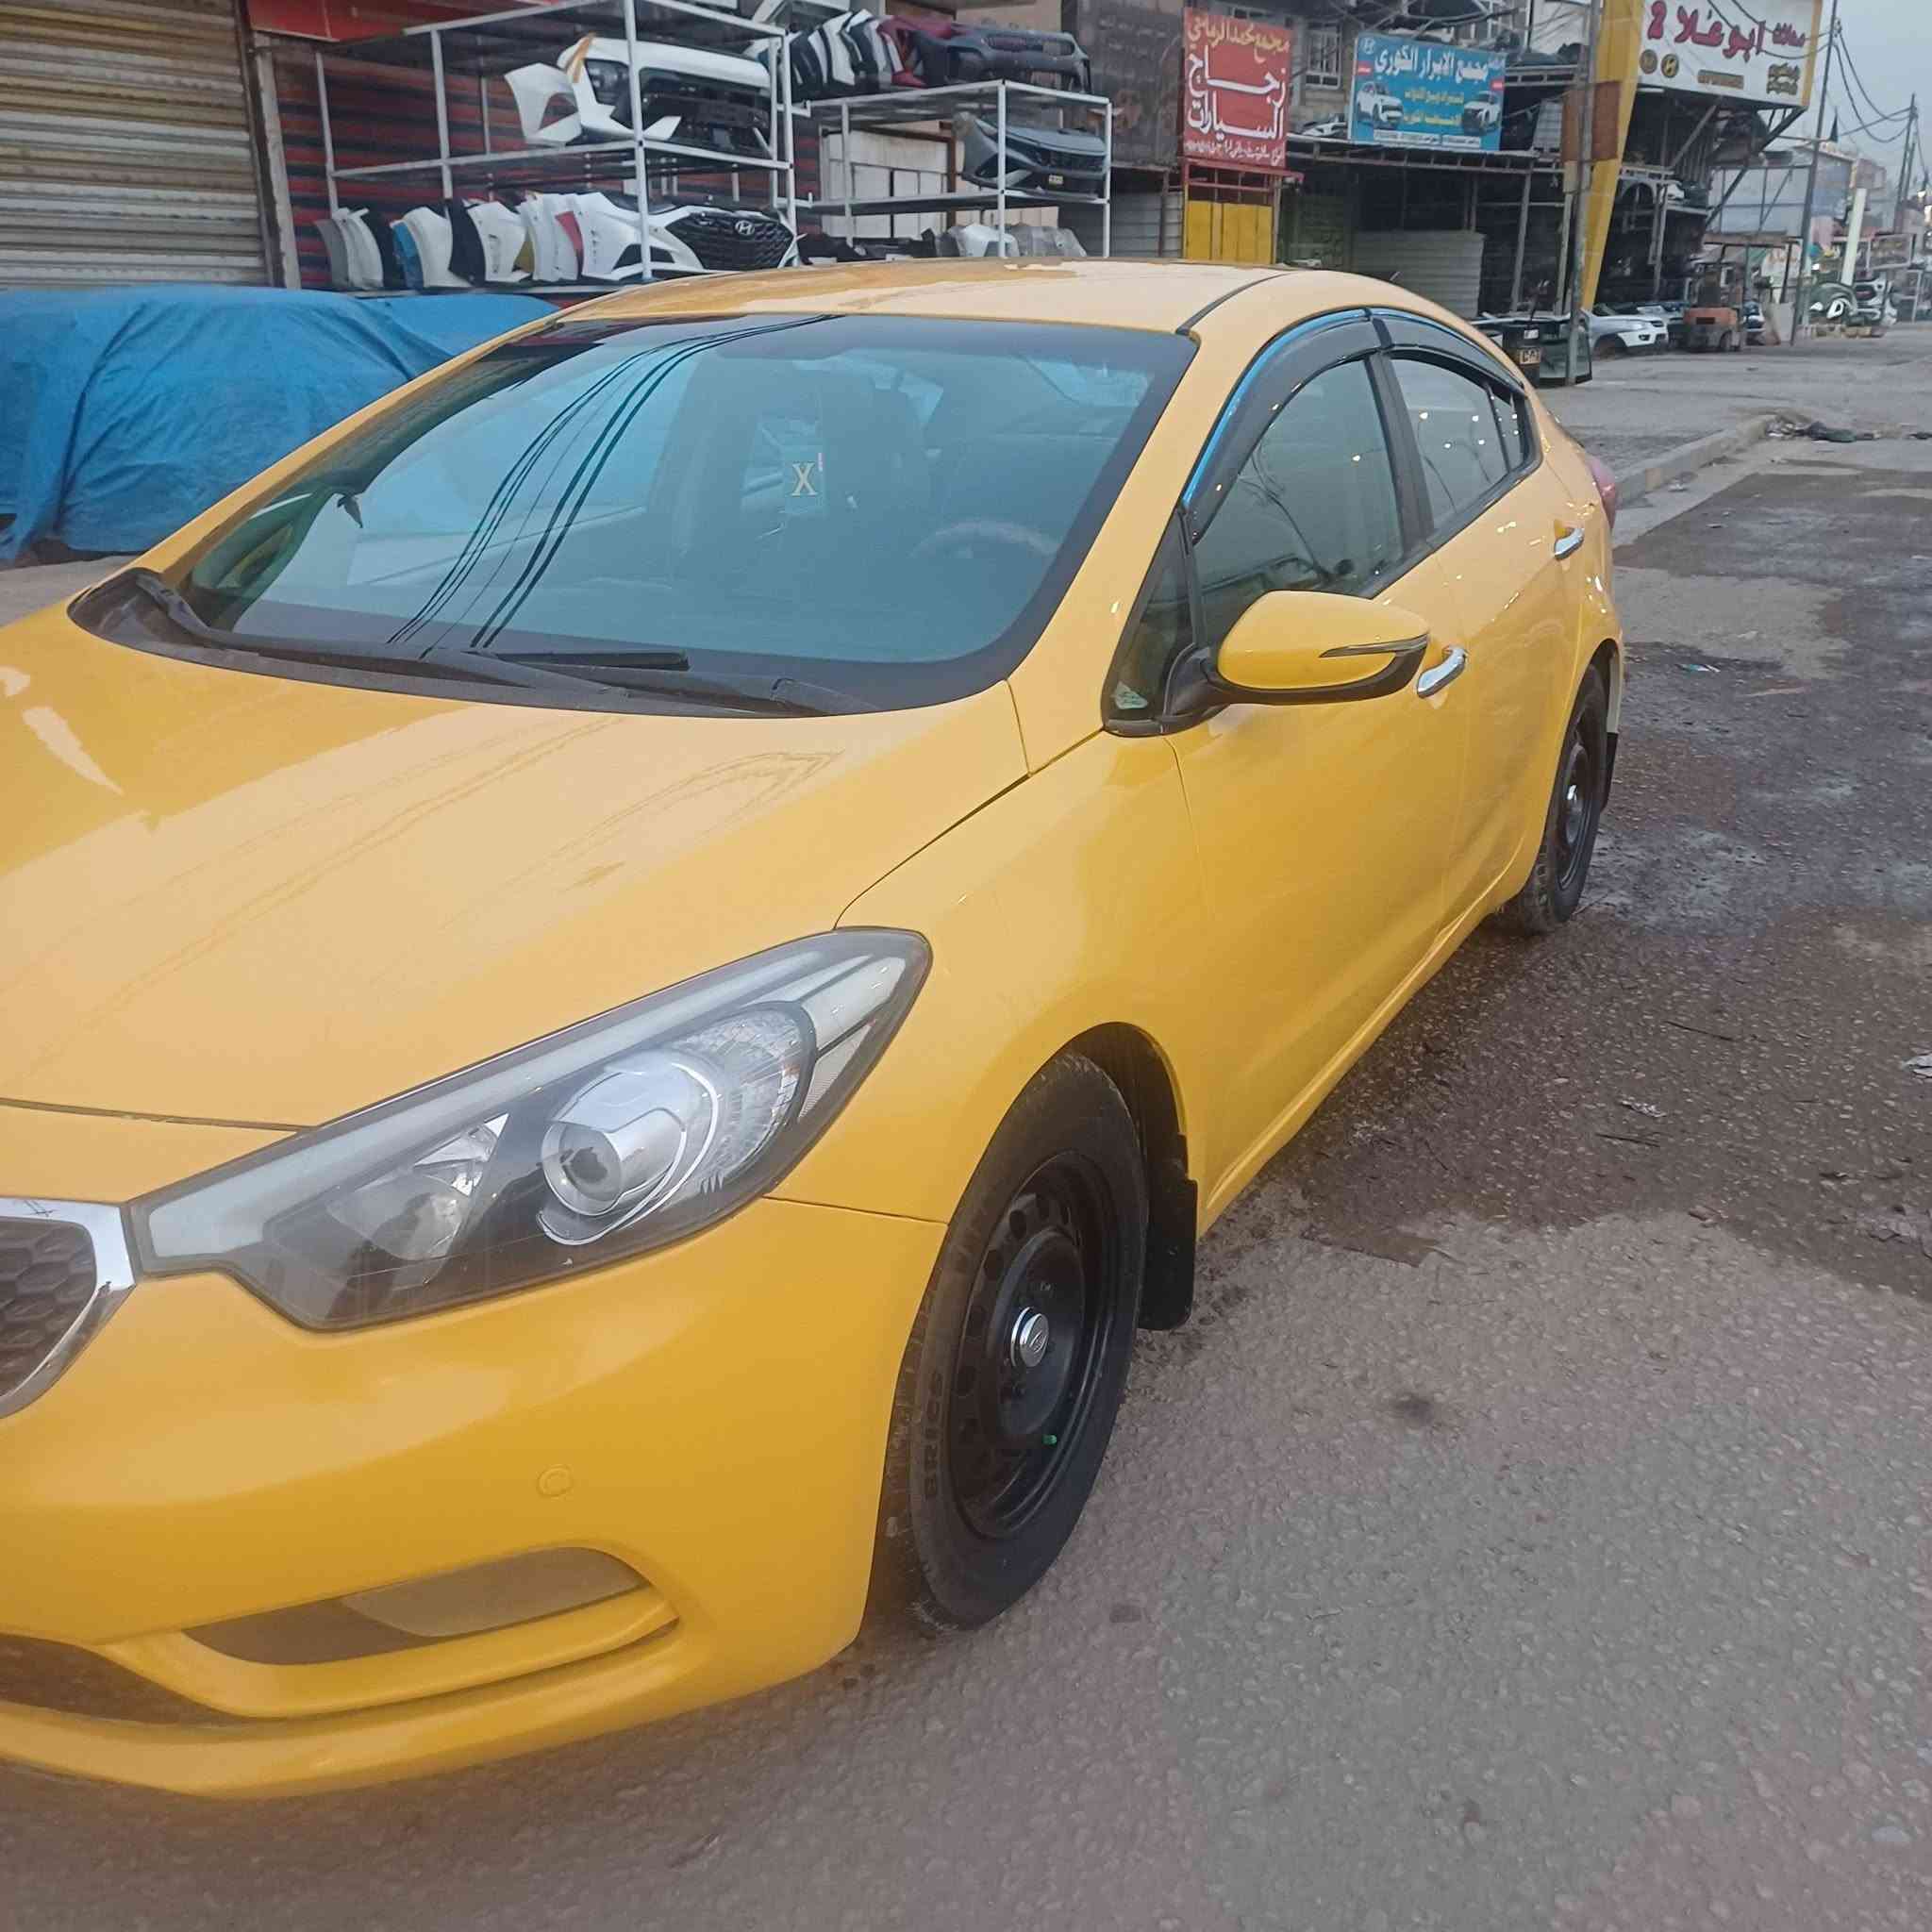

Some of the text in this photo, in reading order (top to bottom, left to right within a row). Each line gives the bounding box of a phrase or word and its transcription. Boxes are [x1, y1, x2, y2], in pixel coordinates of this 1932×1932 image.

[1647, 0, 1667, 40] 2
[1189, 44, 1286, 108] زجاج
[1188, 91, 1284, 142] السيارات
